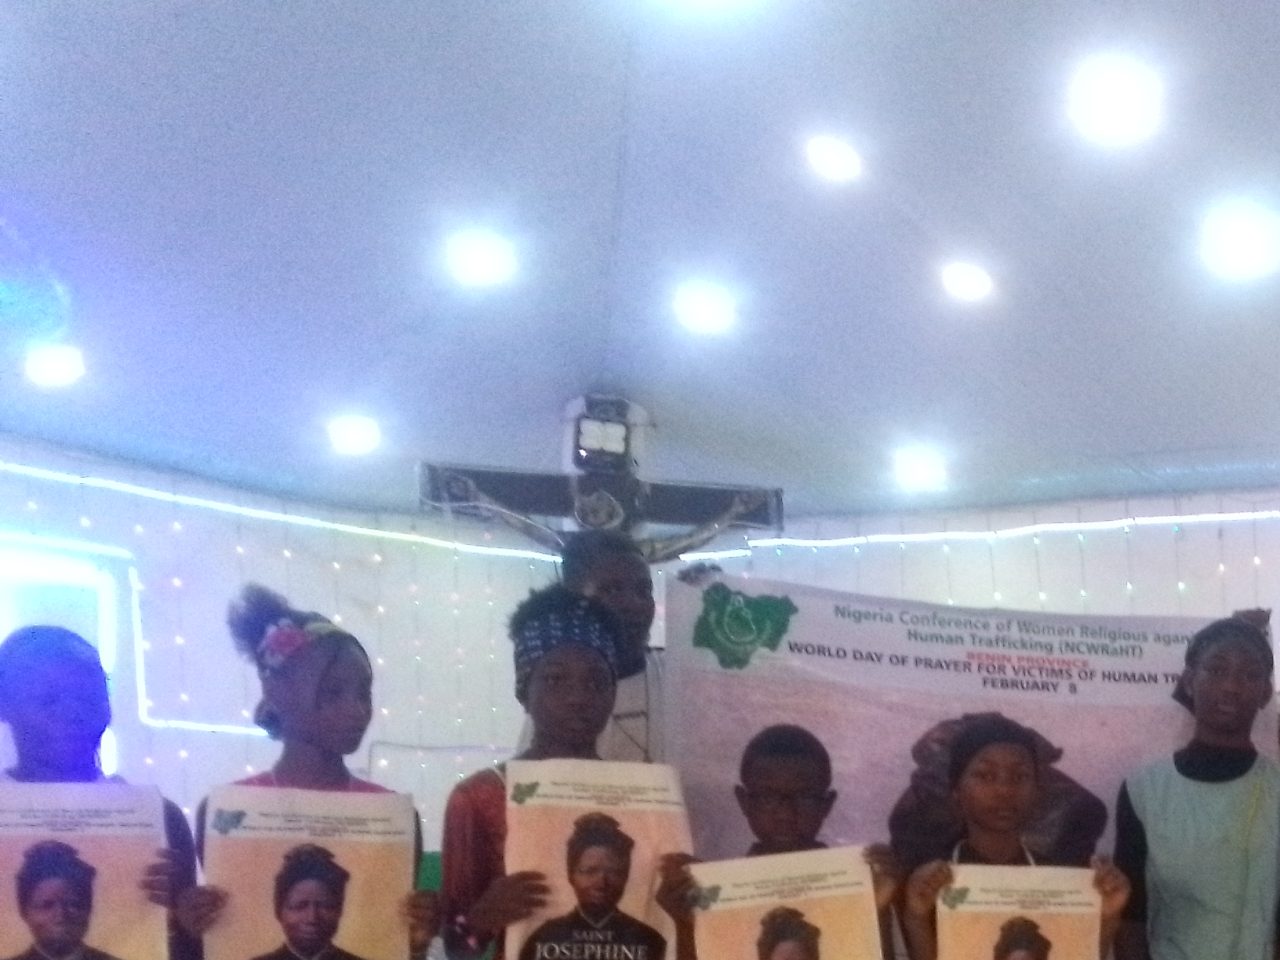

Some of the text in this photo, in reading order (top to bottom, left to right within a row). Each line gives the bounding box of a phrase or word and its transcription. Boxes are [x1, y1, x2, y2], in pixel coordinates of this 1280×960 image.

[833, 605, 894, 624] Nigeria
[899, 611, 990, 631] Conference
[996, 620, 1011, 632] of
[1017, 621, 1074, 636] Women
[1080, 625, 1148, 643] Religious
[907, 629, 1143, 660] Human Trafficking (NCWRaHT)
[788, 640, 1182, 684] WORLD DAY OF PRAYER FOR VICTIMS OF HUMAN TR
[966, 651, 1088, 669] BENIN PROVINCE
[982, 676, 1078, 695] FEBRUARY 8
[572, 930, 614, 941] SAINT
